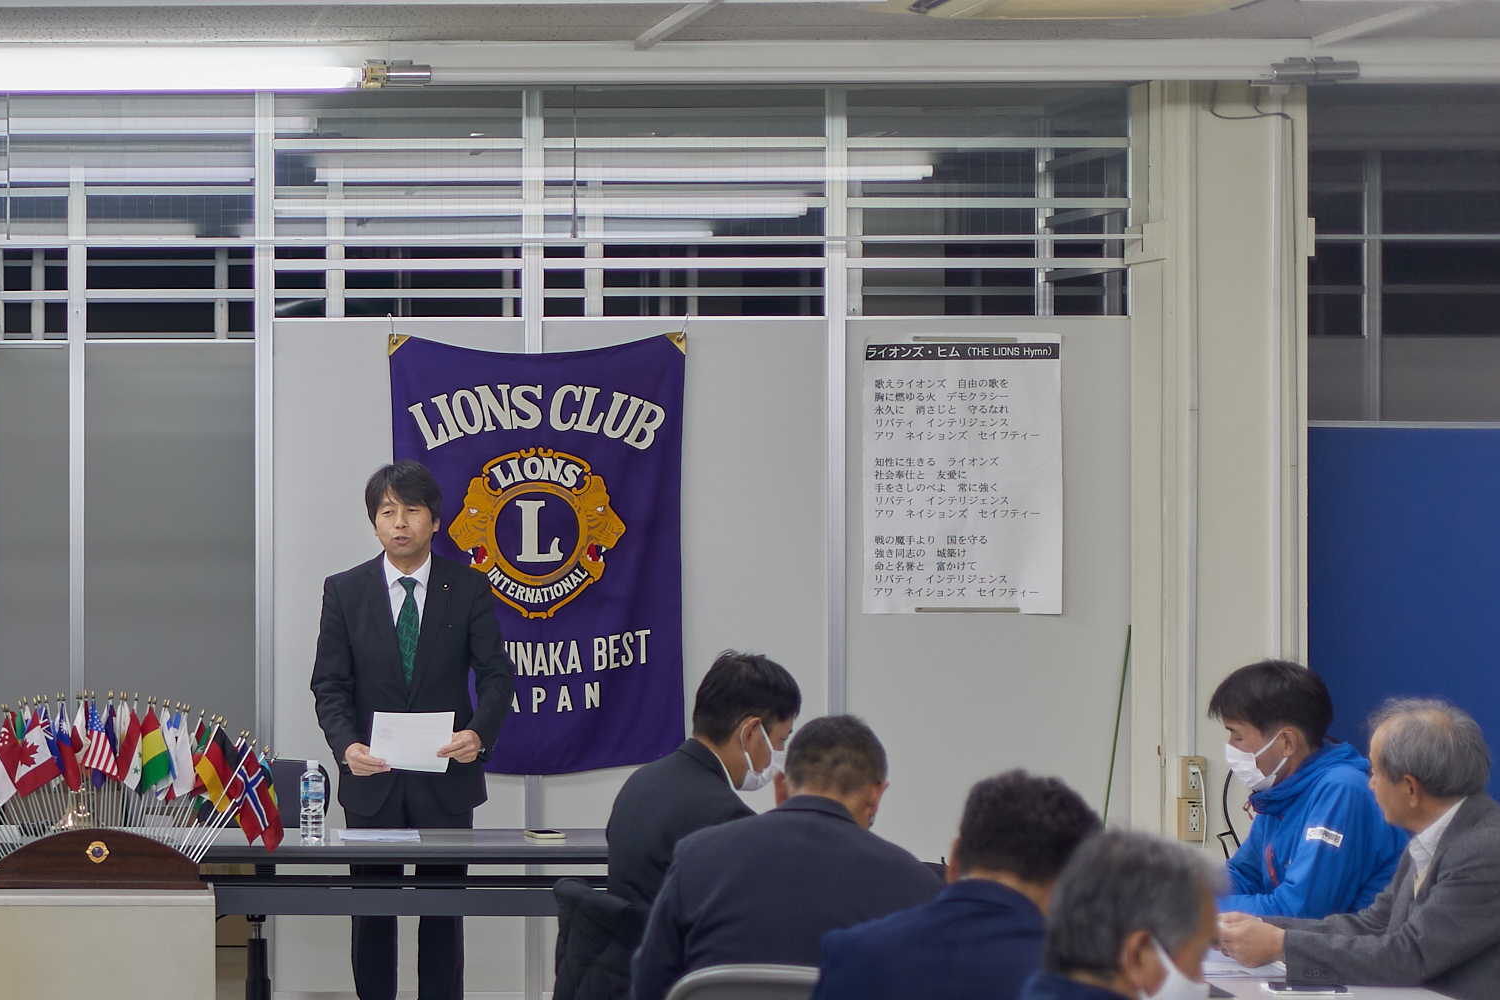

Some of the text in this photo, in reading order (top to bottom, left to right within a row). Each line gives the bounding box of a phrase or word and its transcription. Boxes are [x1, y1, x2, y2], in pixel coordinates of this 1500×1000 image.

[867, 346, 960, 358] ライオンズ・ヒム
[993, 346, 1020, 356] LIONS
[874, 378, 1009, 390] 歌えライオンズ 自由の歌を
[946, 391, 1010, 403] デモクラシー
[874, 404, 905, 416] 永久に
[408, 384, 666, 450] LIONS CLUB
[925, 417, 1009, 429] インテリジェンス
[874, 430, 1040, 442] アワ ネイションズ セイフティー
[874, 456, 1000, 468] 知性に生きる ライオンズ
[490, 456, 582, 489] LIONS
[874, 469, 967, 481] 社会奉仕と 友愛に
[926, 495, 1010, 507] インテリジェンス
[874, 508, 1041, 520] アワ ネイションズ セイフティー
[515, 499, 564, 562] L
[946, 534, 988, 546] 国を守る
[487, 566, 589, 604] INTERNATIONAL
[925, 573, 1008, 585] インテリジェンス
[873, 586, 1039, 598] アワ ネイションズ セイフティー
[504, 629, 651, 676] INAKA BEST
